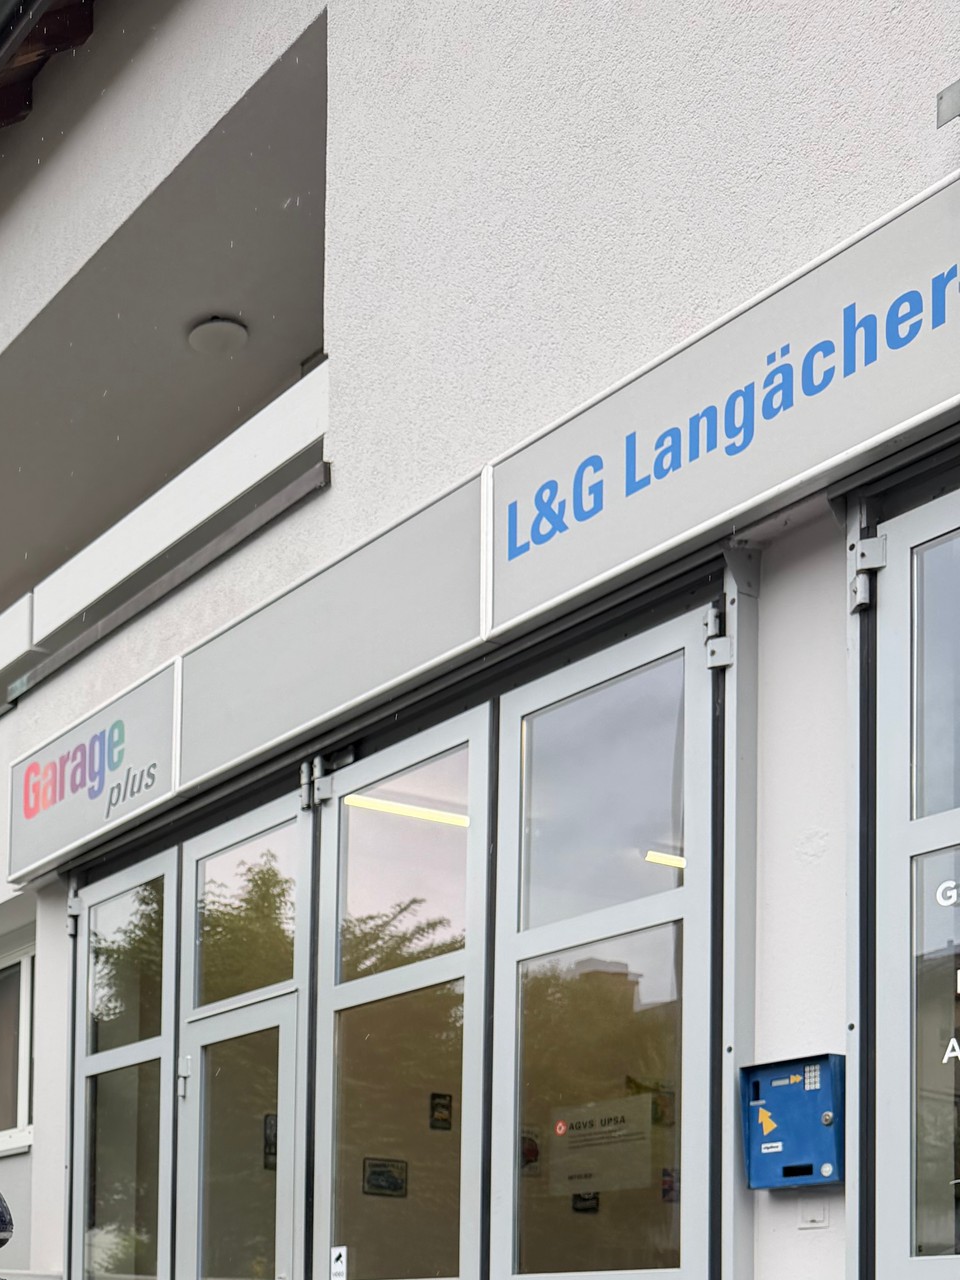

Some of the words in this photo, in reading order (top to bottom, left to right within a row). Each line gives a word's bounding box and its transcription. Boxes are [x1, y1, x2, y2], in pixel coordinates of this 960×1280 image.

[507, 454, 604, 562] L&G
[625, 263, 958, 497] Langächer
[23, 719, 125, 820] Garage
[105, 762, 157, 819] plus
